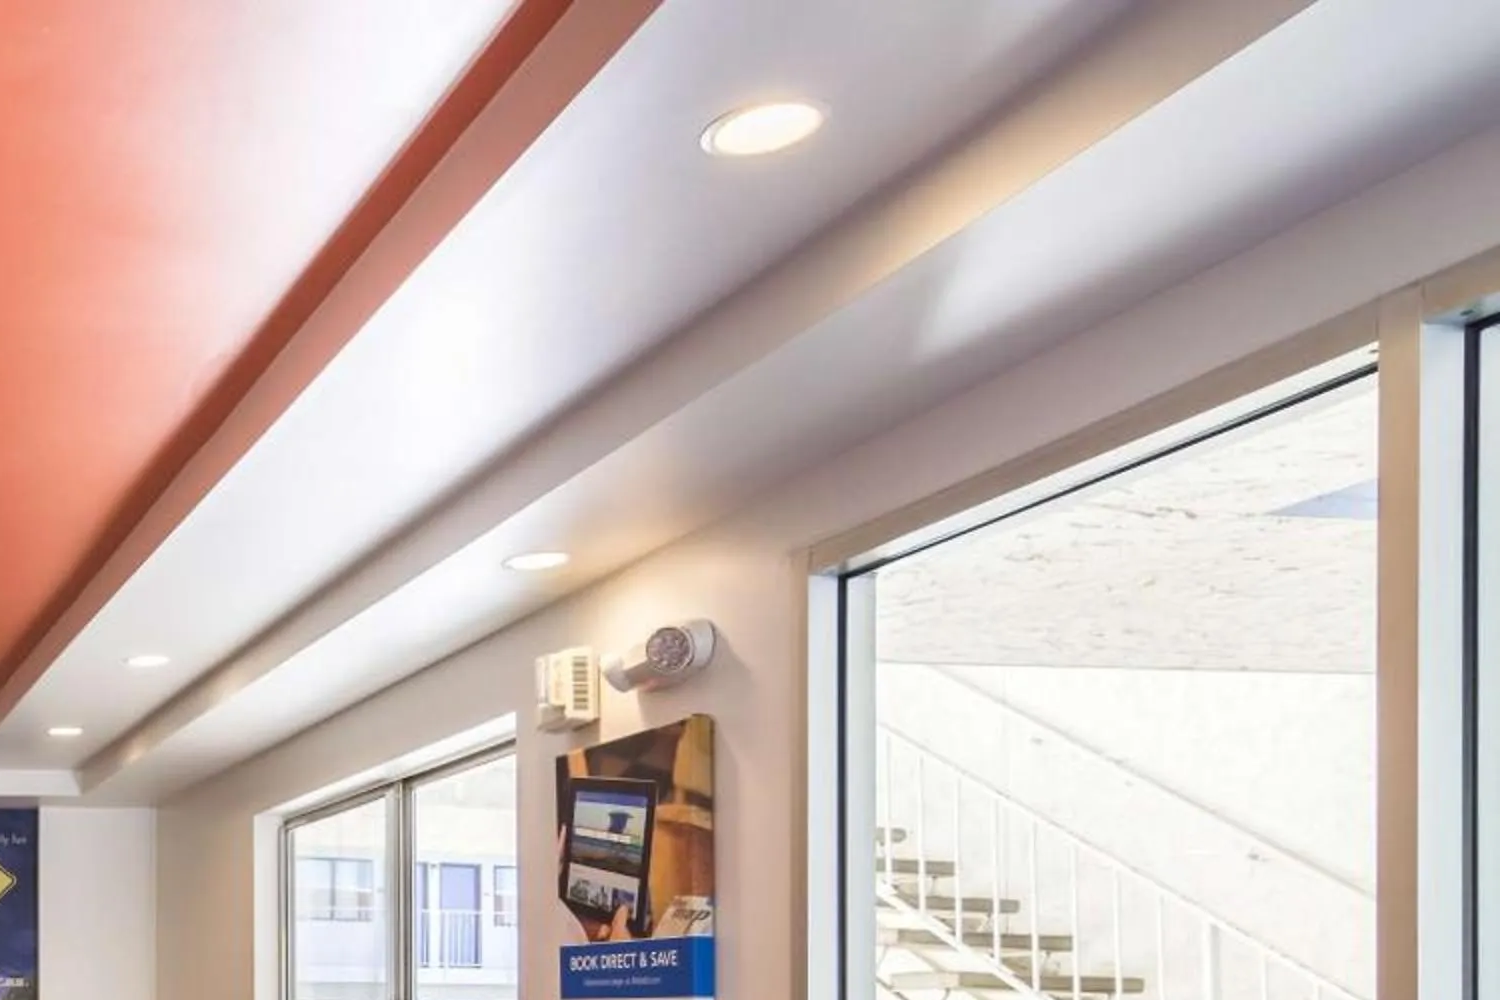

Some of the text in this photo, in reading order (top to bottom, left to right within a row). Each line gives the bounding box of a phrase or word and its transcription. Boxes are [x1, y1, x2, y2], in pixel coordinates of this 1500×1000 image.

[569, 950, 678, 972] BOOK DIRECT & SAVE
